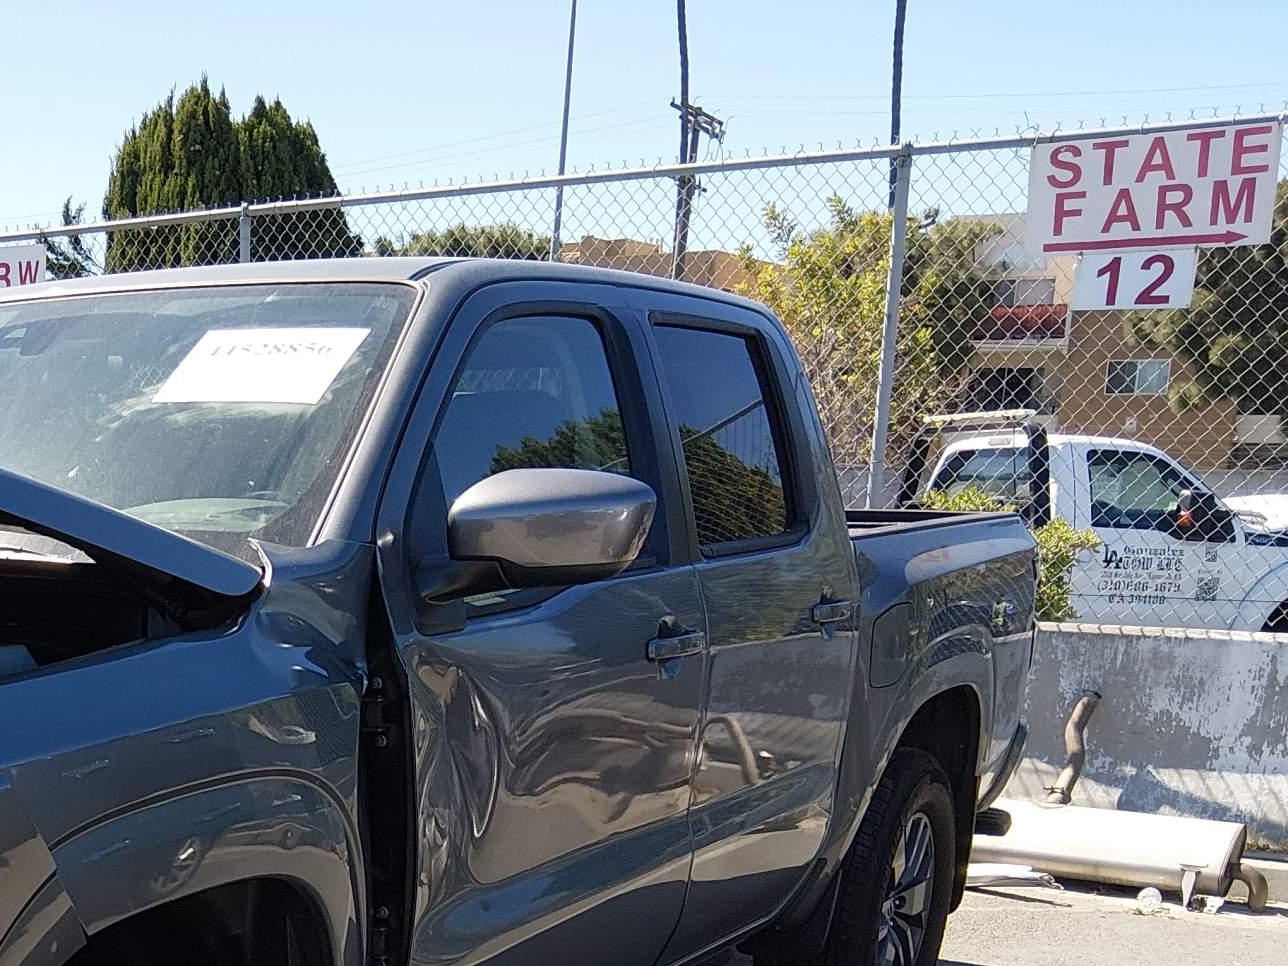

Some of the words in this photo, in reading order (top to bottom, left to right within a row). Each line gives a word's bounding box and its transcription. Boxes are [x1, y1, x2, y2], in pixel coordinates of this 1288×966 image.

[1047, 125, 1274, 189] STATE
[1053, 177, 1257, 237] FARM
[1096, 254, 1176, 307] 12
